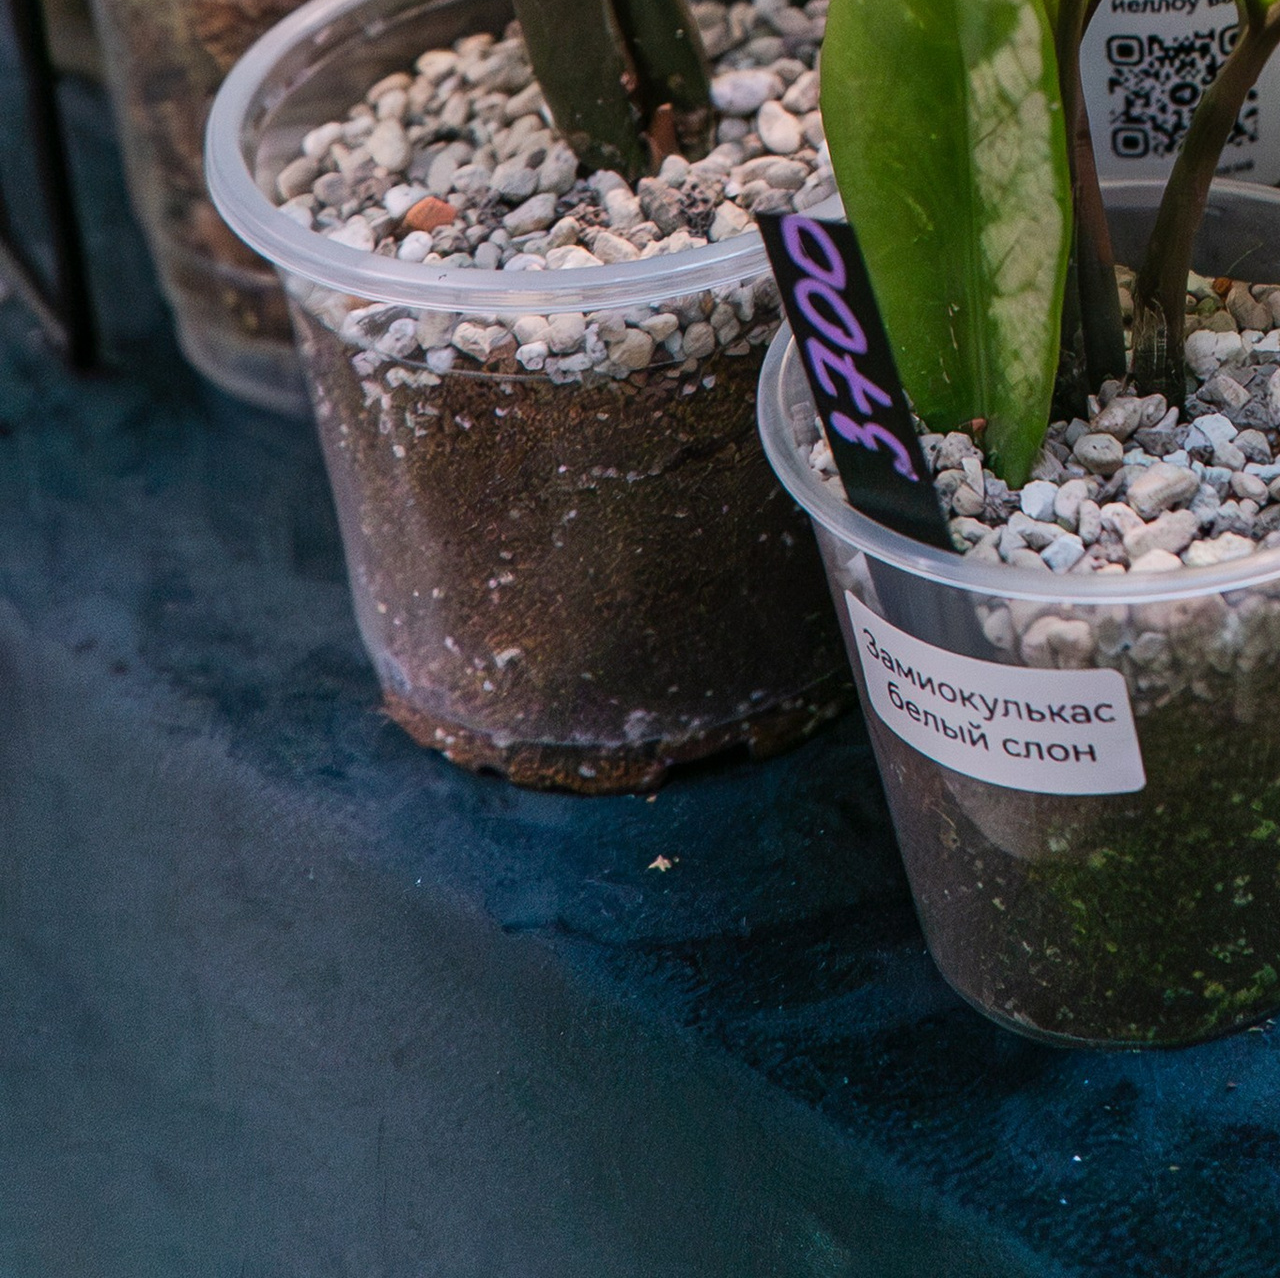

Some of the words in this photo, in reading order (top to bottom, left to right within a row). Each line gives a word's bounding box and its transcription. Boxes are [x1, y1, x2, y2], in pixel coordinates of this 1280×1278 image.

[780, 213, 920, 483] 3700
[862, 627, 1117, 725] Замиокулькас
[887, 680, 990, 751] белый
[1001, 736, 1098, 763] слон
